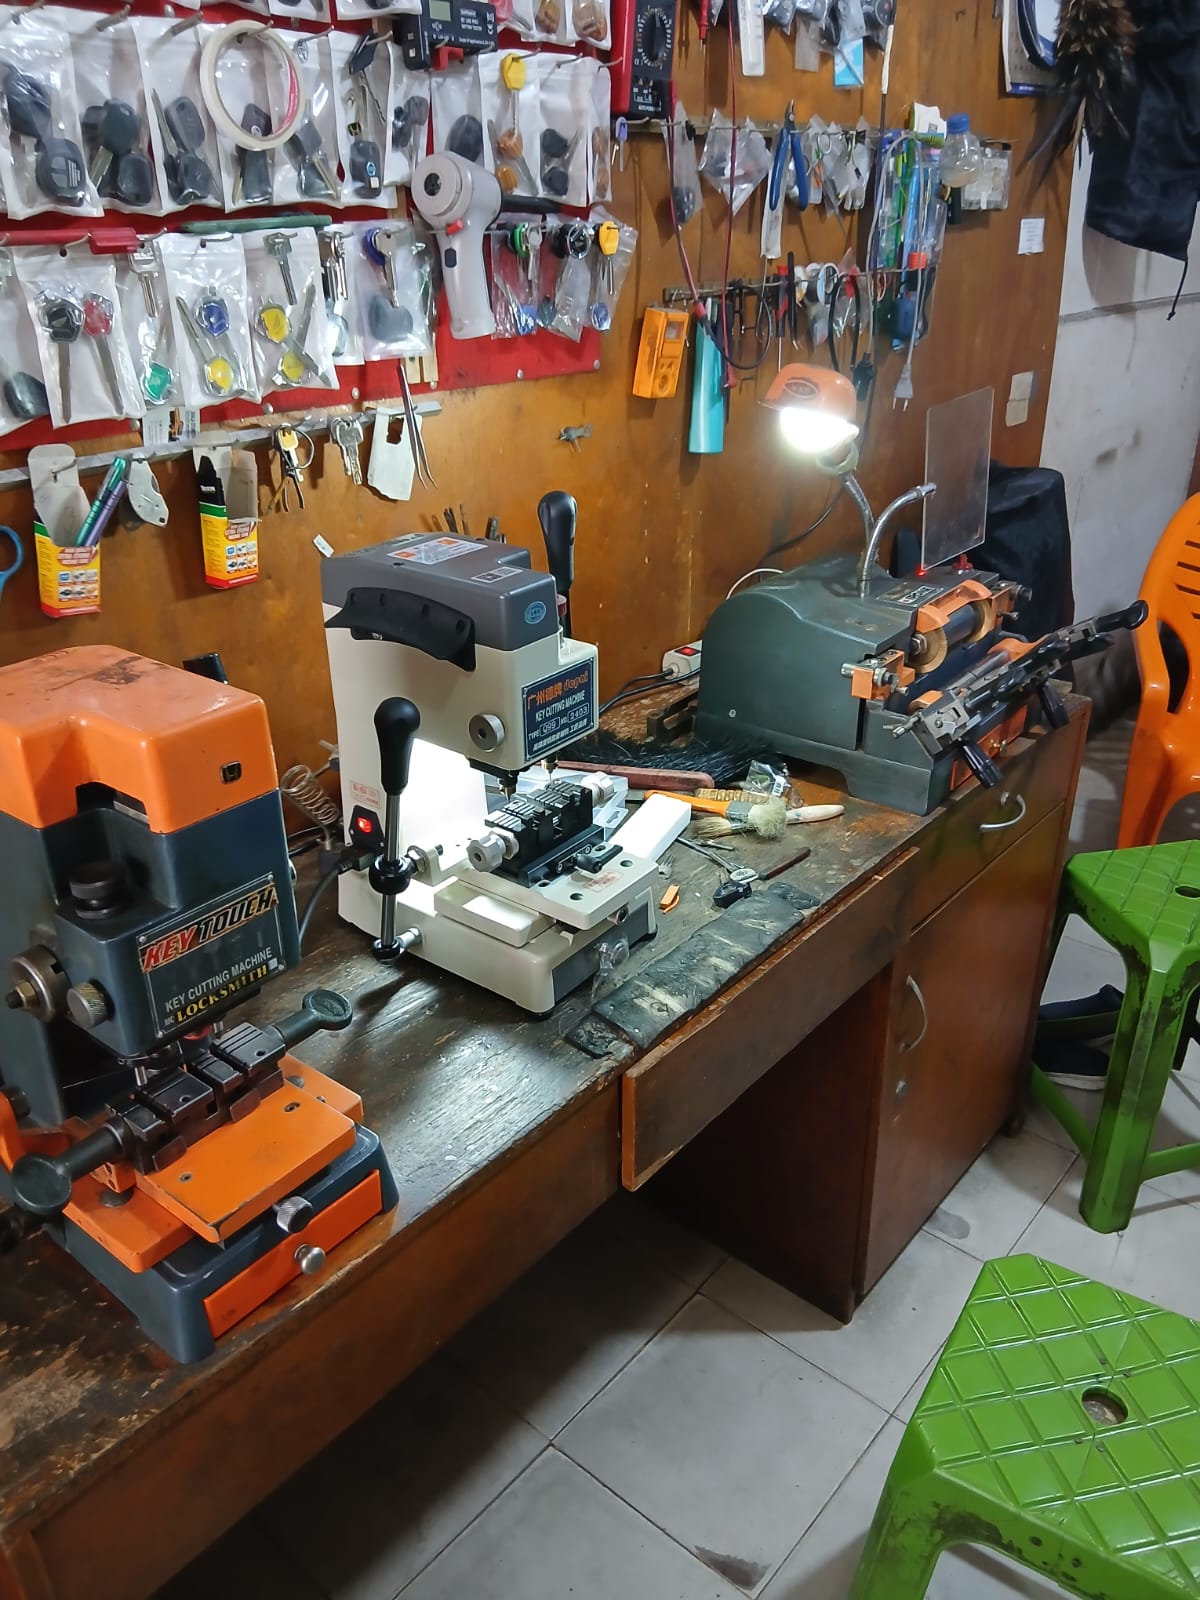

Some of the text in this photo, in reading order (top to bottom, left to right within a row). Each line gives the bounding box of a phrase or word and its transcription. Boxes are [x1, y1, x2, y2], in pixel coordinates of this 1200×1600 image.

[528, 730, 540, 741] TYPE
[535, 690, 585, 723] KEY CUTTING MACHINE
[143, 887, 274, 971] KEY TOUCH
[165, 947, 273, 1013] KEY CUTTING MACHINE
[176, 964, 267, 1022] LOCKSMITH
